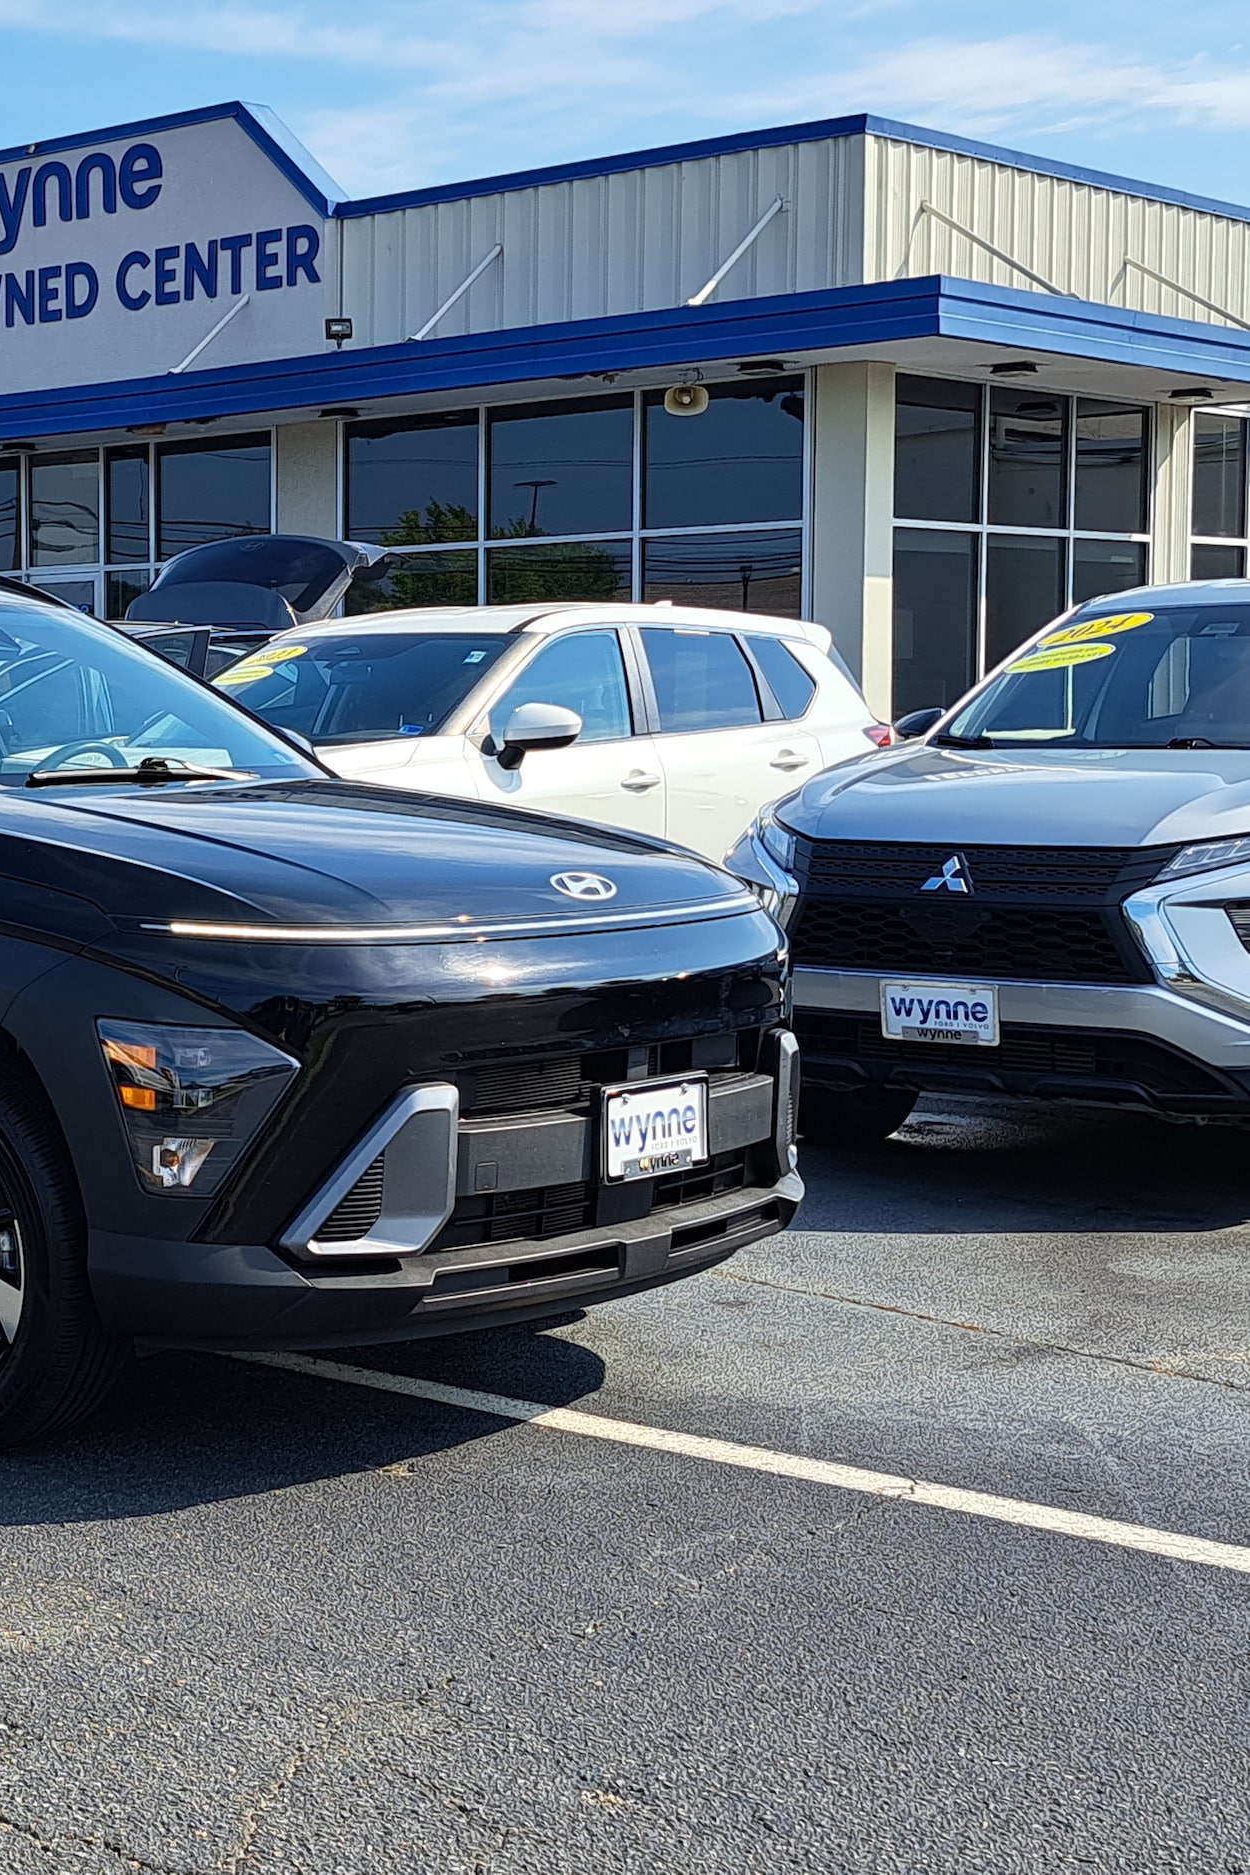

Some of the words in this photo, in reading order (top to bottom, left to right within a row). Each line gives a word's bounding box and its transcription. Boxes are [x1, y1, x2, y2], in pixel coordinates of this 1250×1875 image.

[116, 224, 321, 311] CENTER
[890, 997, 989, 1025] wynne
[917, 1028, 962, 1041] wynne
[610, 1104, 696, 1153] wynne
